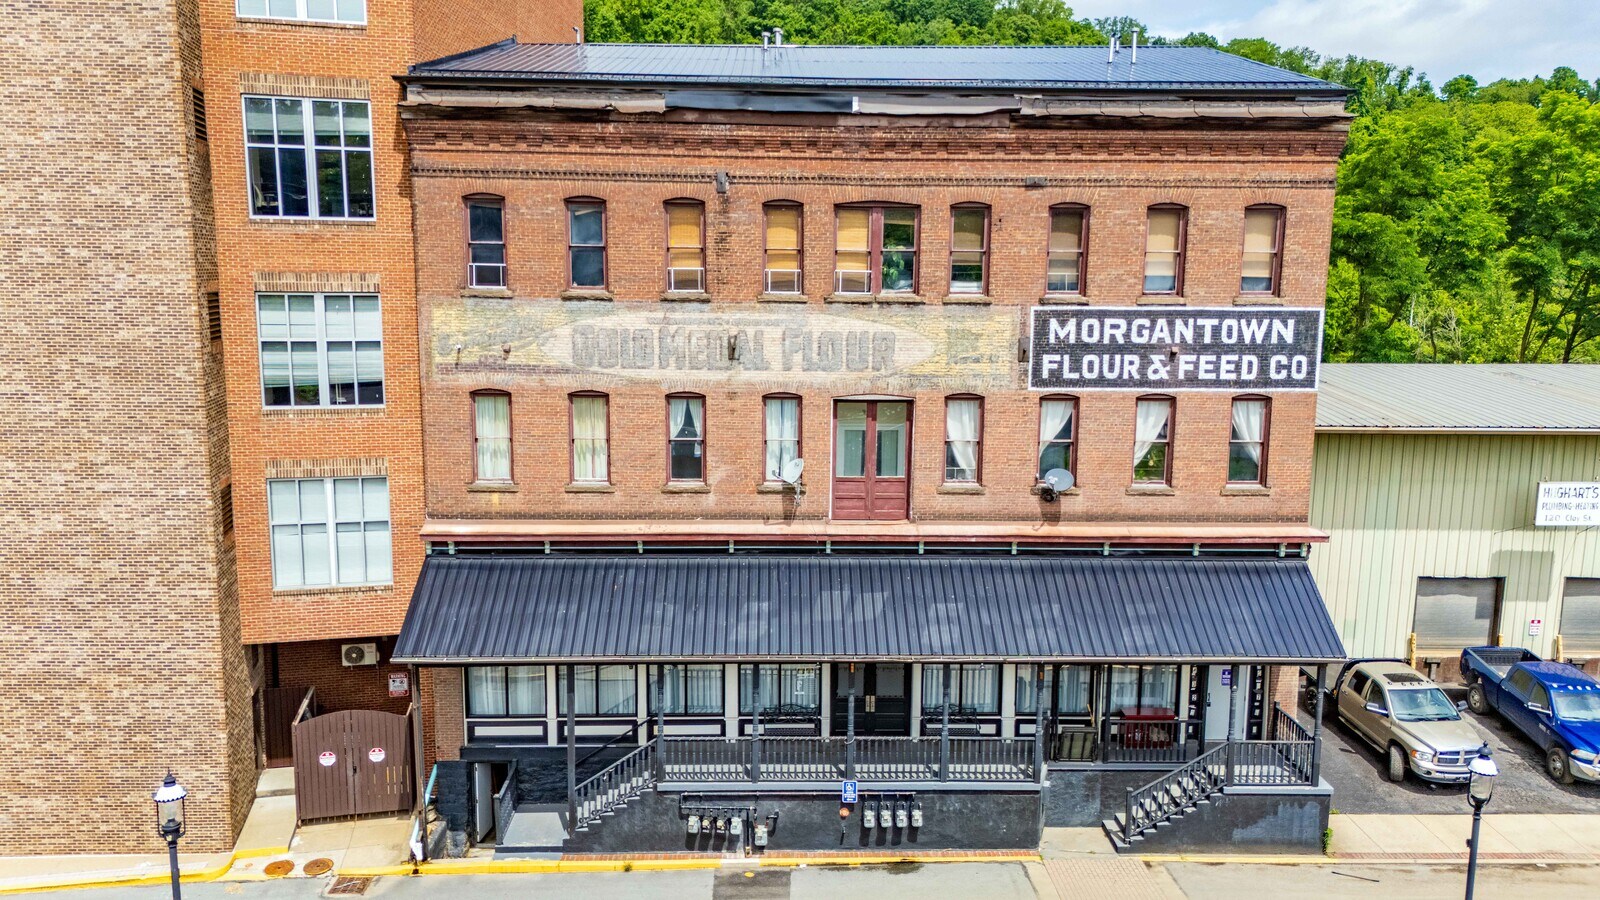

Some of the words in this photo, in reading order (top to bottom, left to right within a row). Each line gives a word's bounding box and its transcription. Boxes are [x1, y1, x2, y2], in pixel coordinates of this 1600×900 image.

[1048, 318, 1296, 345] MORGANTOWN
[780, 327, 897, 373] FLOUR
[1041, 353, 1140, 380] FLOUR
[1147, 355, 1171, 381] &
[1177, 354, 1259, 380] FEED
[1268, 354, 1309, 380] CO
